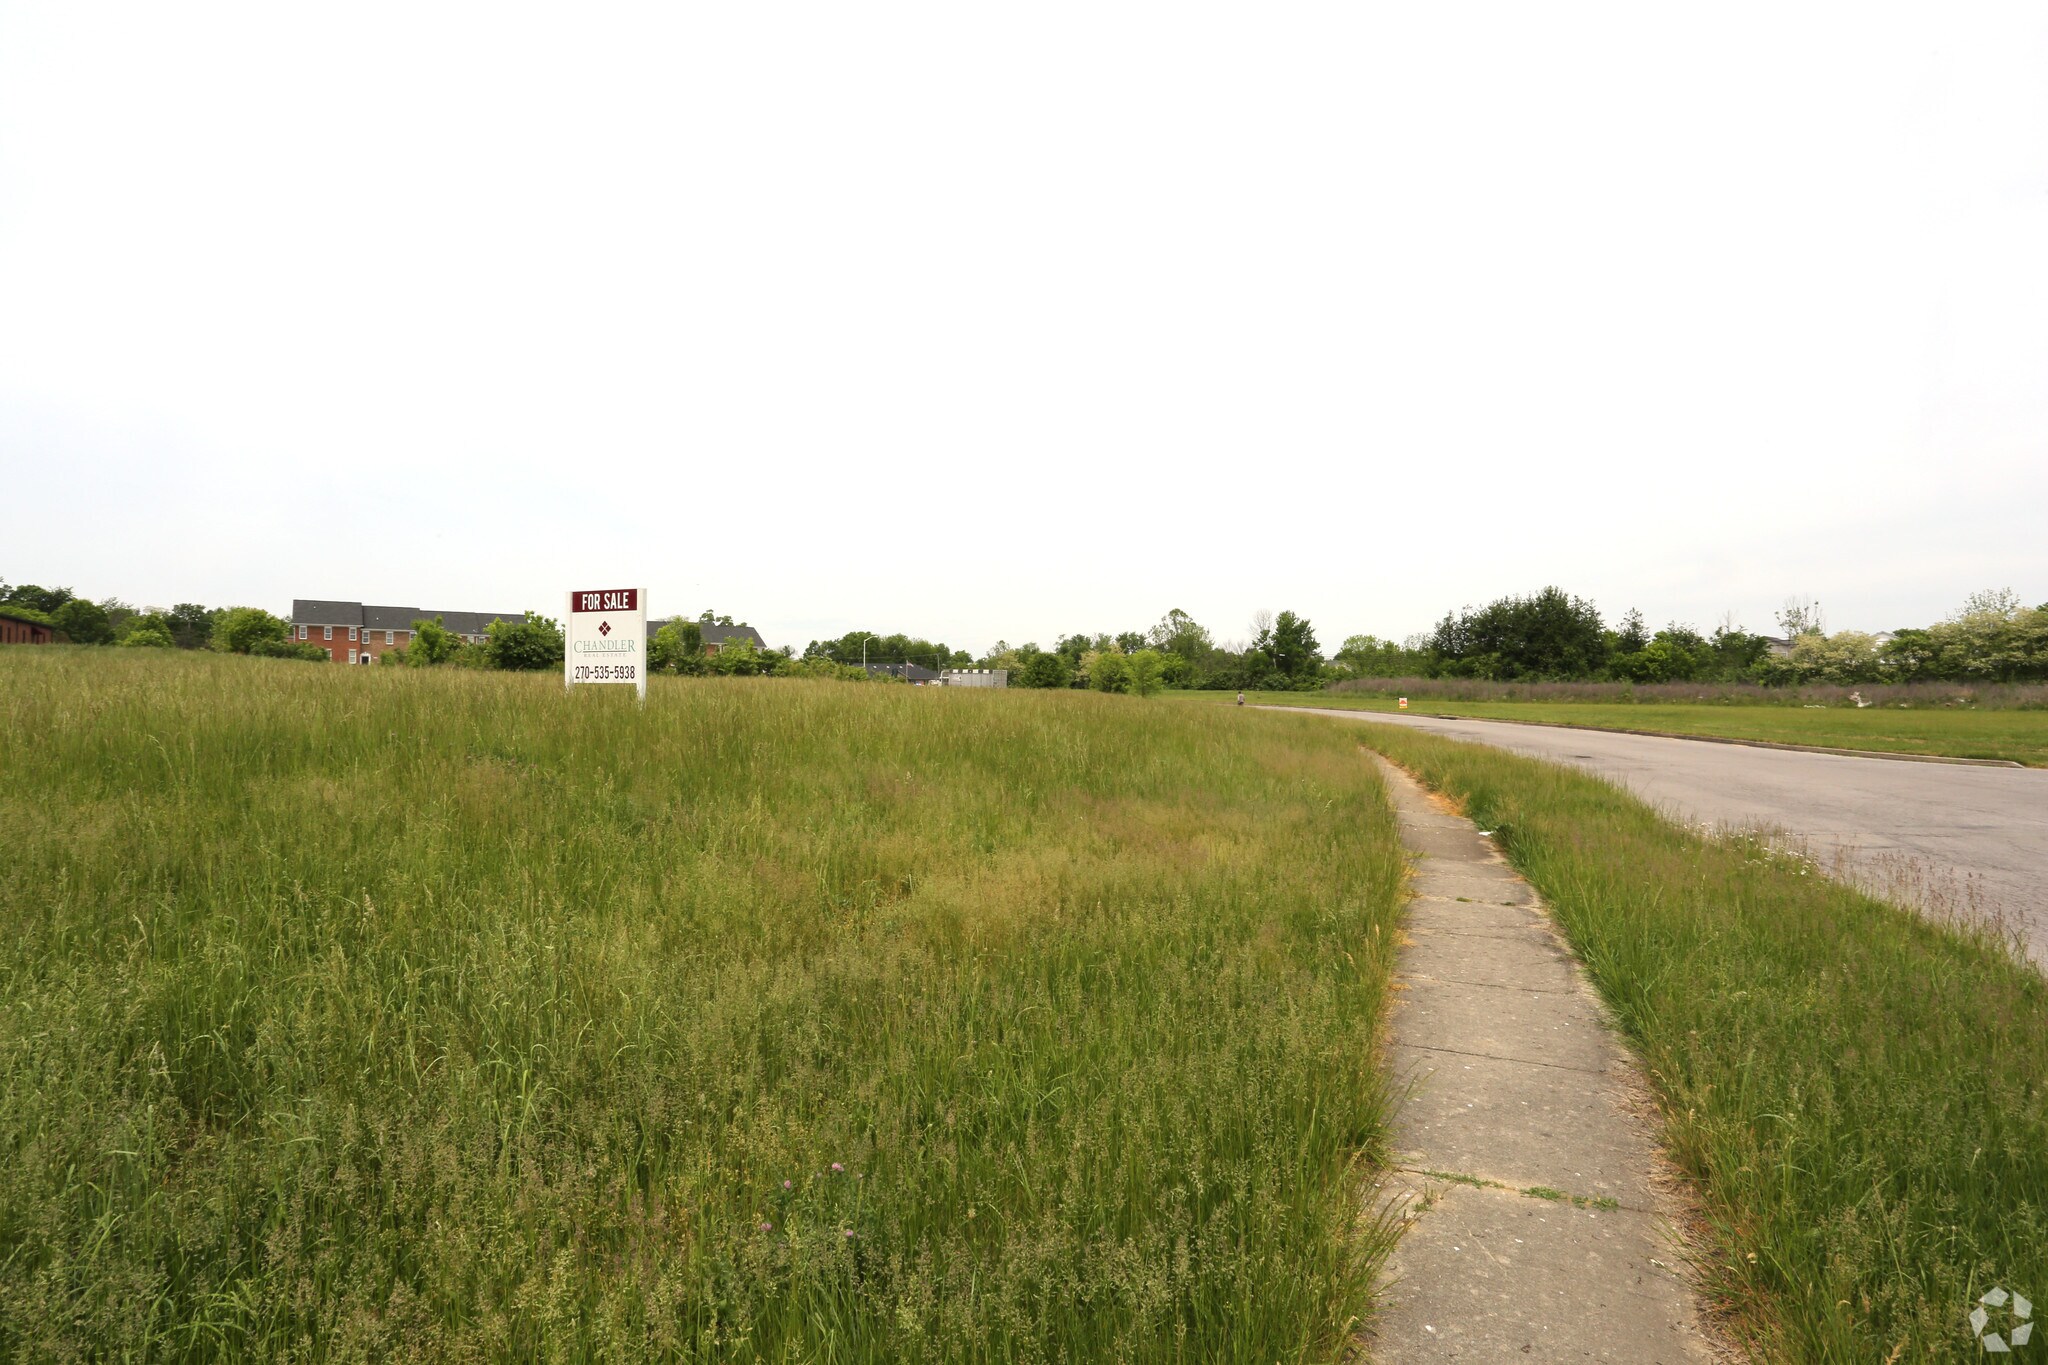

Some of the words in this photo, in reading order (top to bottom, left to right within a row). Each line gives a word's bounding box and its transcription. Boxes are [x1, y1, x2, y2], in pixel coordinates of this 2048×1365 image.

[582, 594, 600, 610] FOR
[604, 592, 629, 610] SALE
[574, 639, 636, 653] CHANDLER
[575, 665, 635, 679] 270-535-5938
